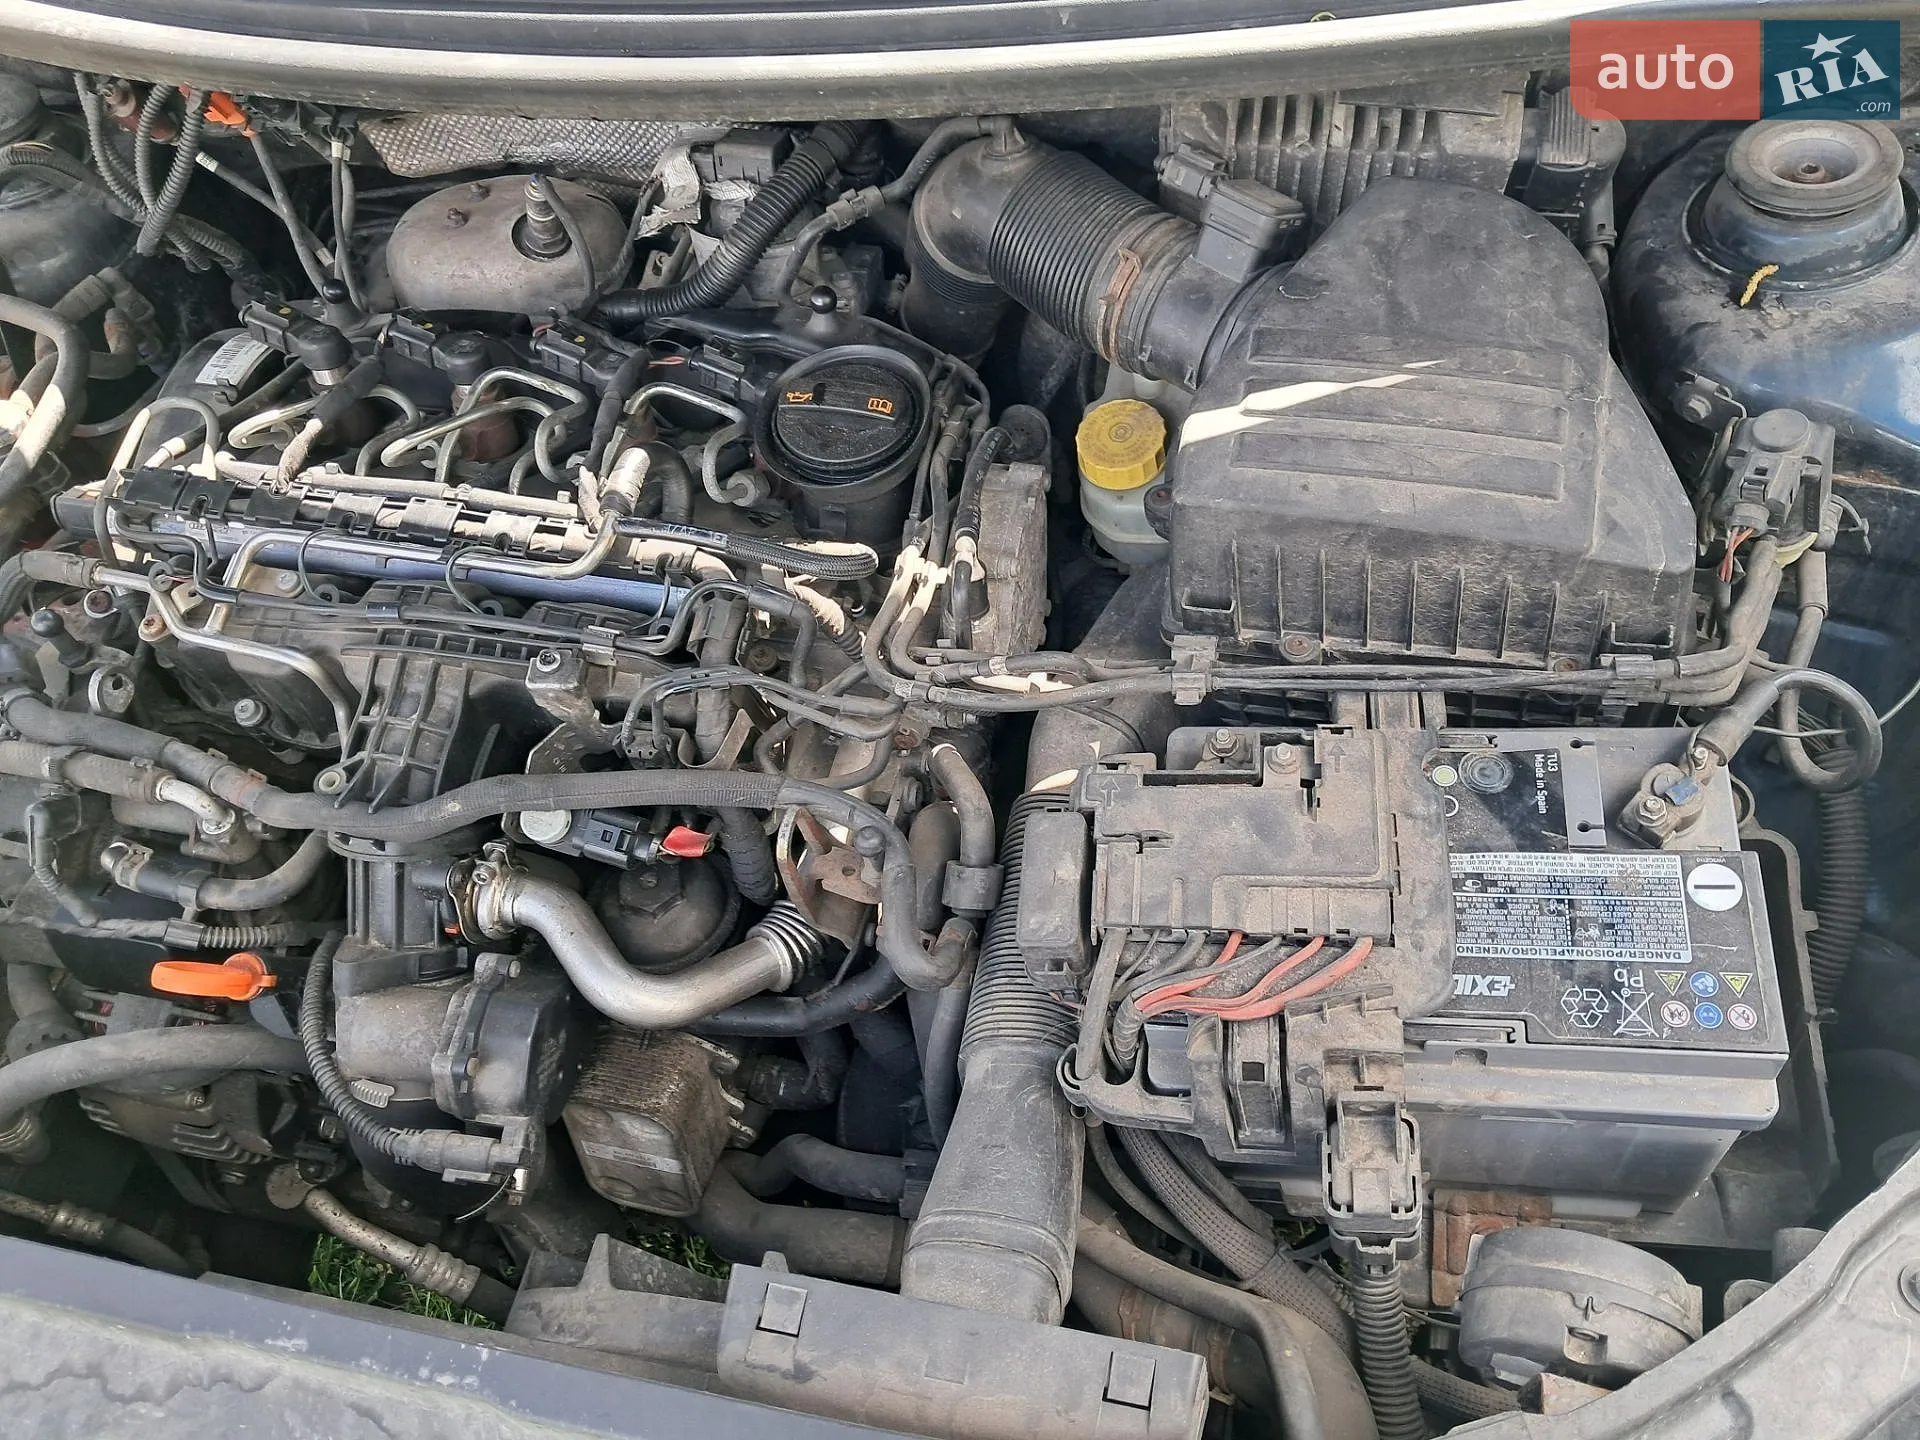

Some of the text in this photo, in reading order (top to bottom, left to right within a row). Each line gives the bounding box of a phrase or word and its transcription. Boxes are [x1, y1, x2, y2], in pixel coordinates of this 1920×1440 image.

[1547, 753, 1558, 772] TU3
[1534, 754, 1549, 814] Made in Spain
[1457, 946, 1682, 960] DANGER/POISON PELIGRO/VENENO
[1613, 968, 1644, 988] Pb
